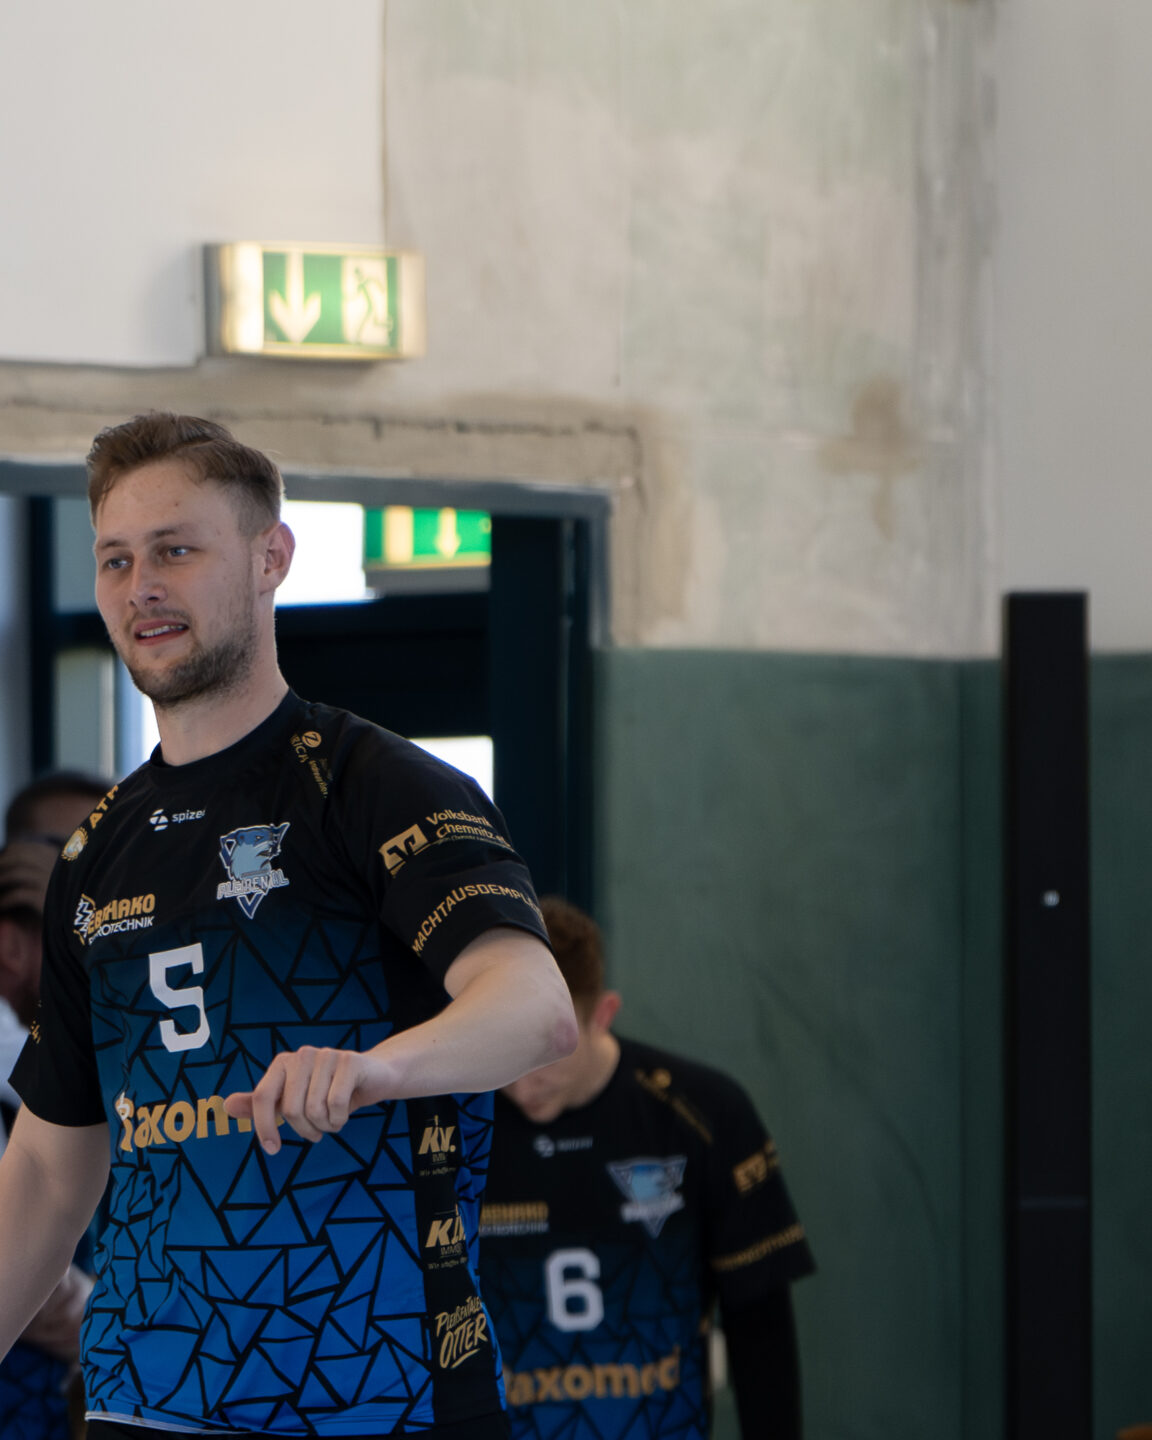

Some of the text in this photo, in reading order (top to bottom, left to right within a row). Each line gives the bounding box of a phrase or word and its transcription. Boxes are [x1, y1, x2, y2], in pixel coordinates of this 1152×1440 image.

[149, 942, 211, 1053] 5
[546, 1246, 605, 1332] 6
[439, 1312, 488, 1369] OTTER
